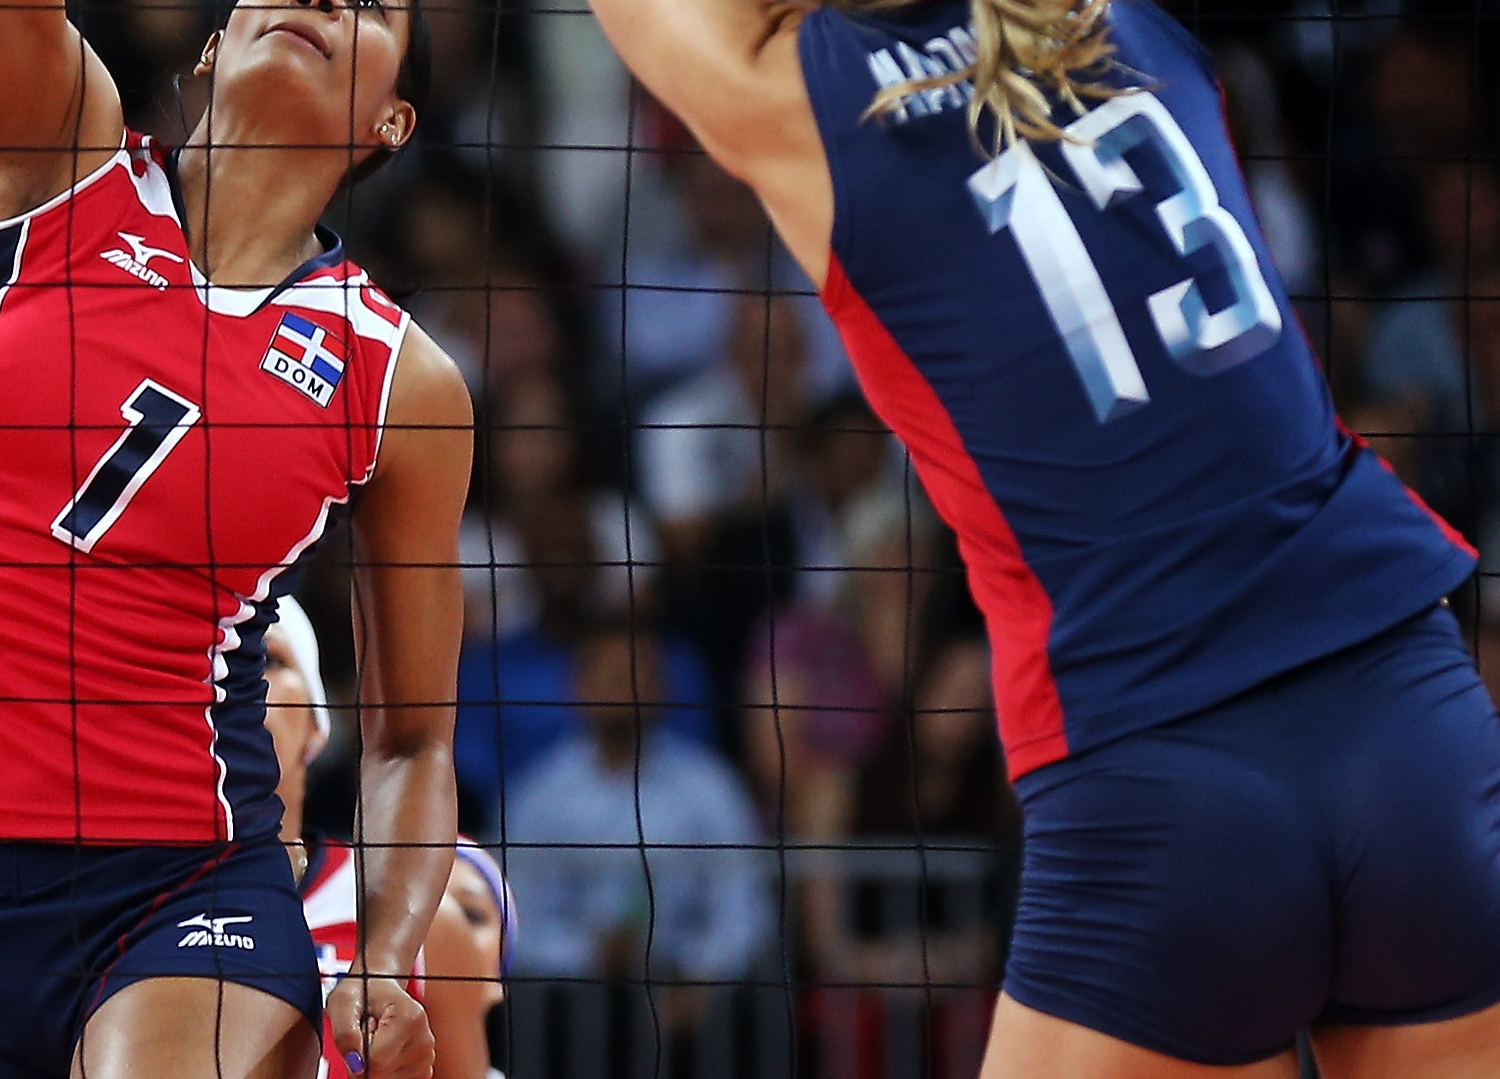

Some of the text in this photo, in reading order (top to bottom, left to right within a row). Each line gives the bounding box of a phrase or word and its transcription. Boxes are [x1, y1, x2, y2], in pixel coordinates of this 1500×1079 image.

[967, 86, 1283, 424] 13
[50, 377, 203, 555] 1
[273, 356, 326, 399] DOM
